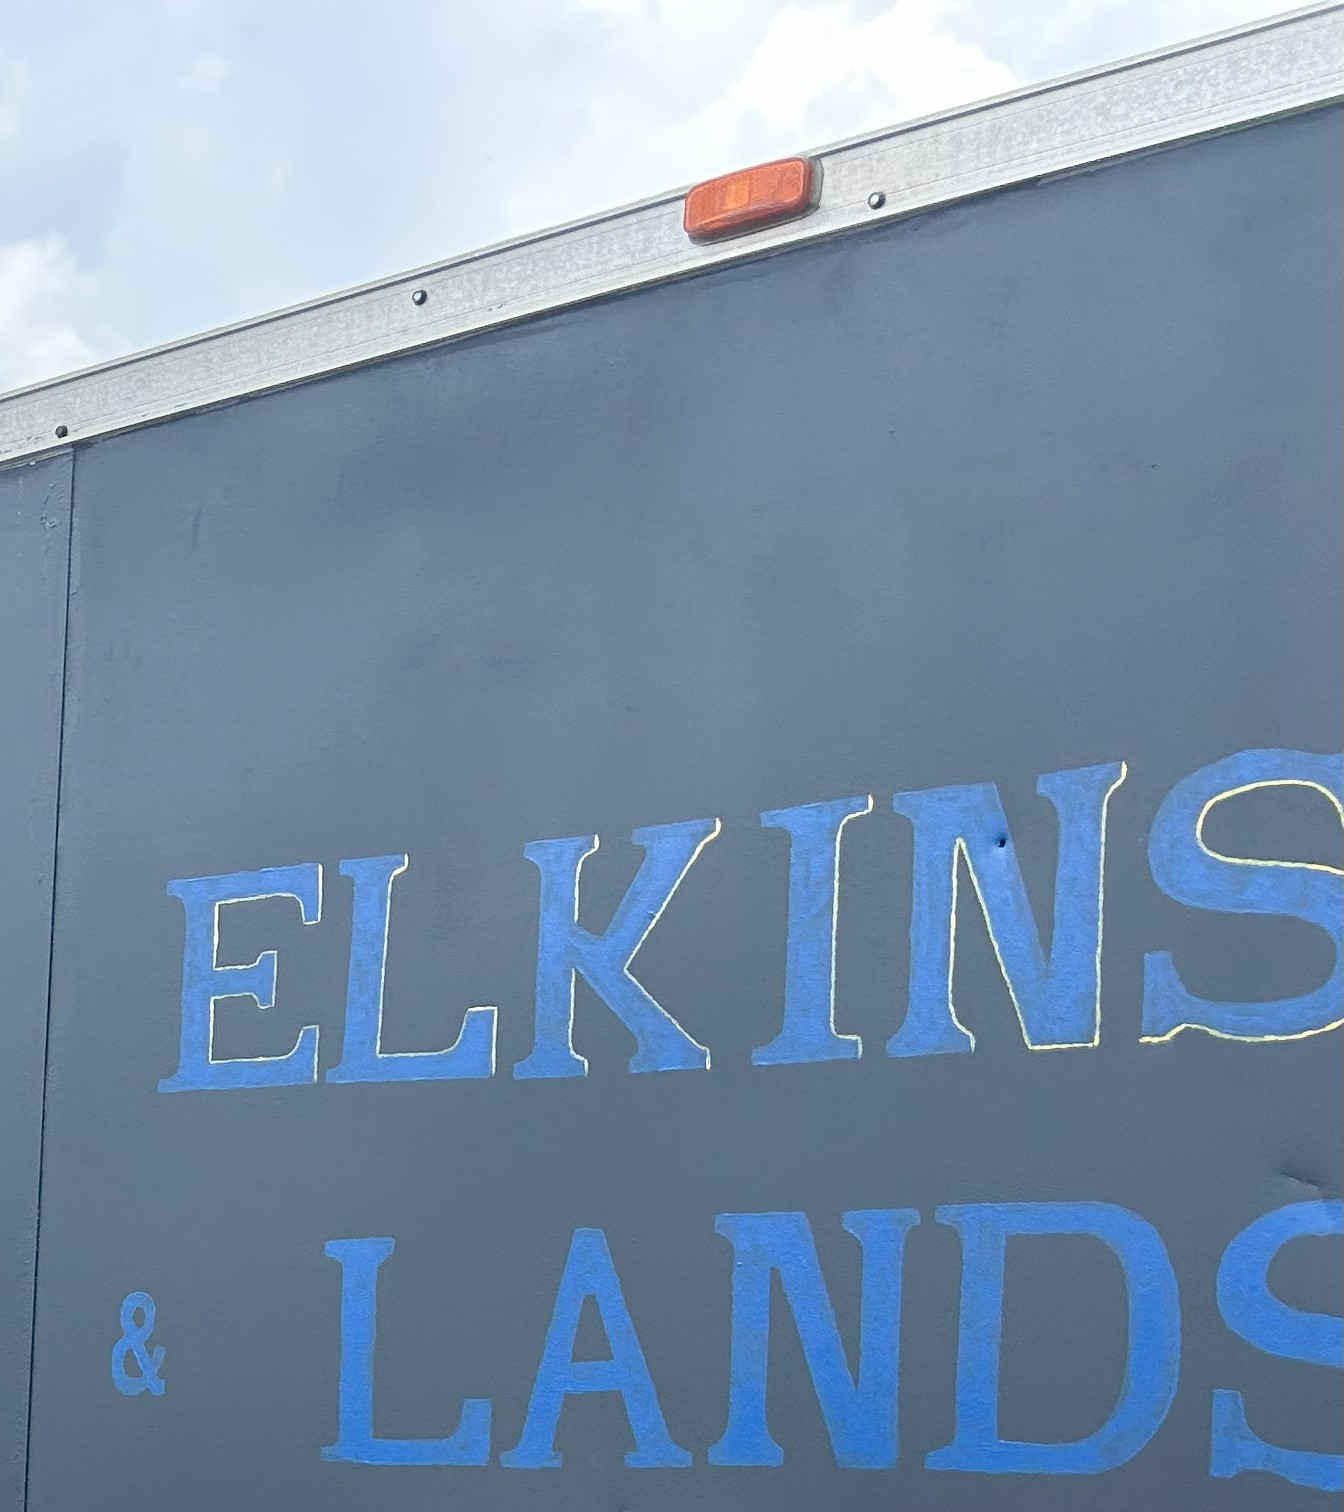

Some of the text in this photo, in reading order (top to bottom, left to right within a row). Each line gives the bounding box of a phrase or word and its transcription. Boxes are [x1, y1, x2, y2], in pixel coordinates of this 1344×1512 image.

[158, 747, 1344, 1093] ELKINS
[111, 1291, 166, 1397] &
[320, 1199, 1344, 1491] LANDS
